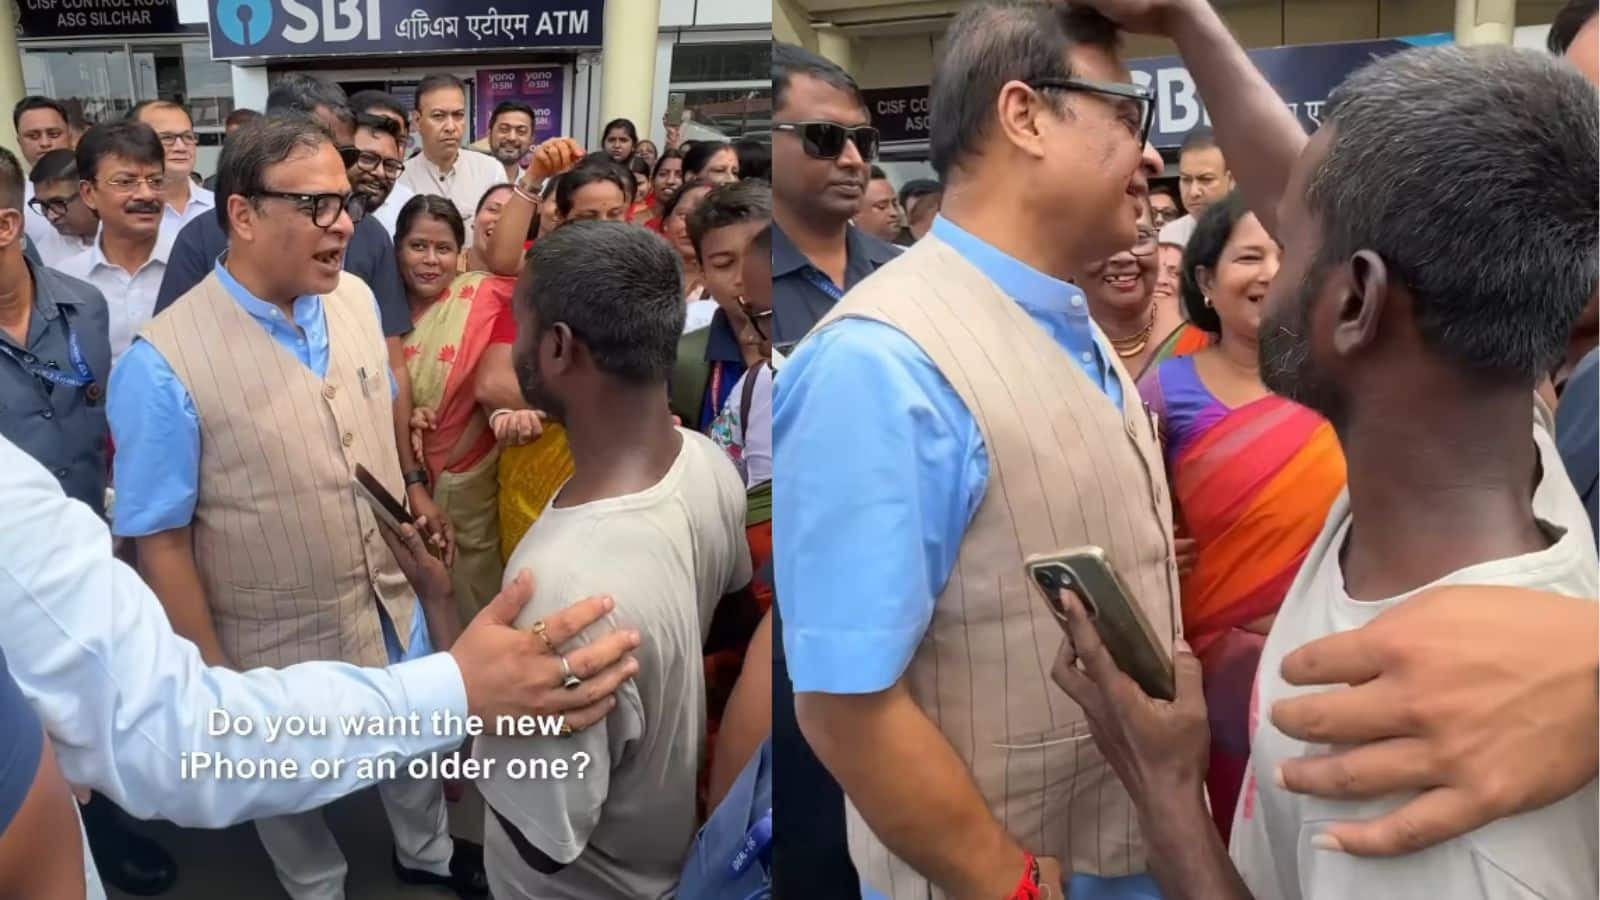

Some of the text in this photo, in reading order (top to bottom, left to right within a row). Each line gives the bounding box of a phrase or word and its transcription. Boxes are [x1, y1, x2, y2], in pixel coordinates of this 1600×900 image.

[57, 10, 152, 27] ASG SILCHAR
[281, 0, 381, 44] SBI
[395, 8, 459, 40] এটিএম
[465, 7, 530, 40] एटीएम
[535, 9, 590, 36] ATM
[488, 72, 516, 82] yono
[525, 71, 552, 82] yono
[877, 98, 908, 115] CISF
